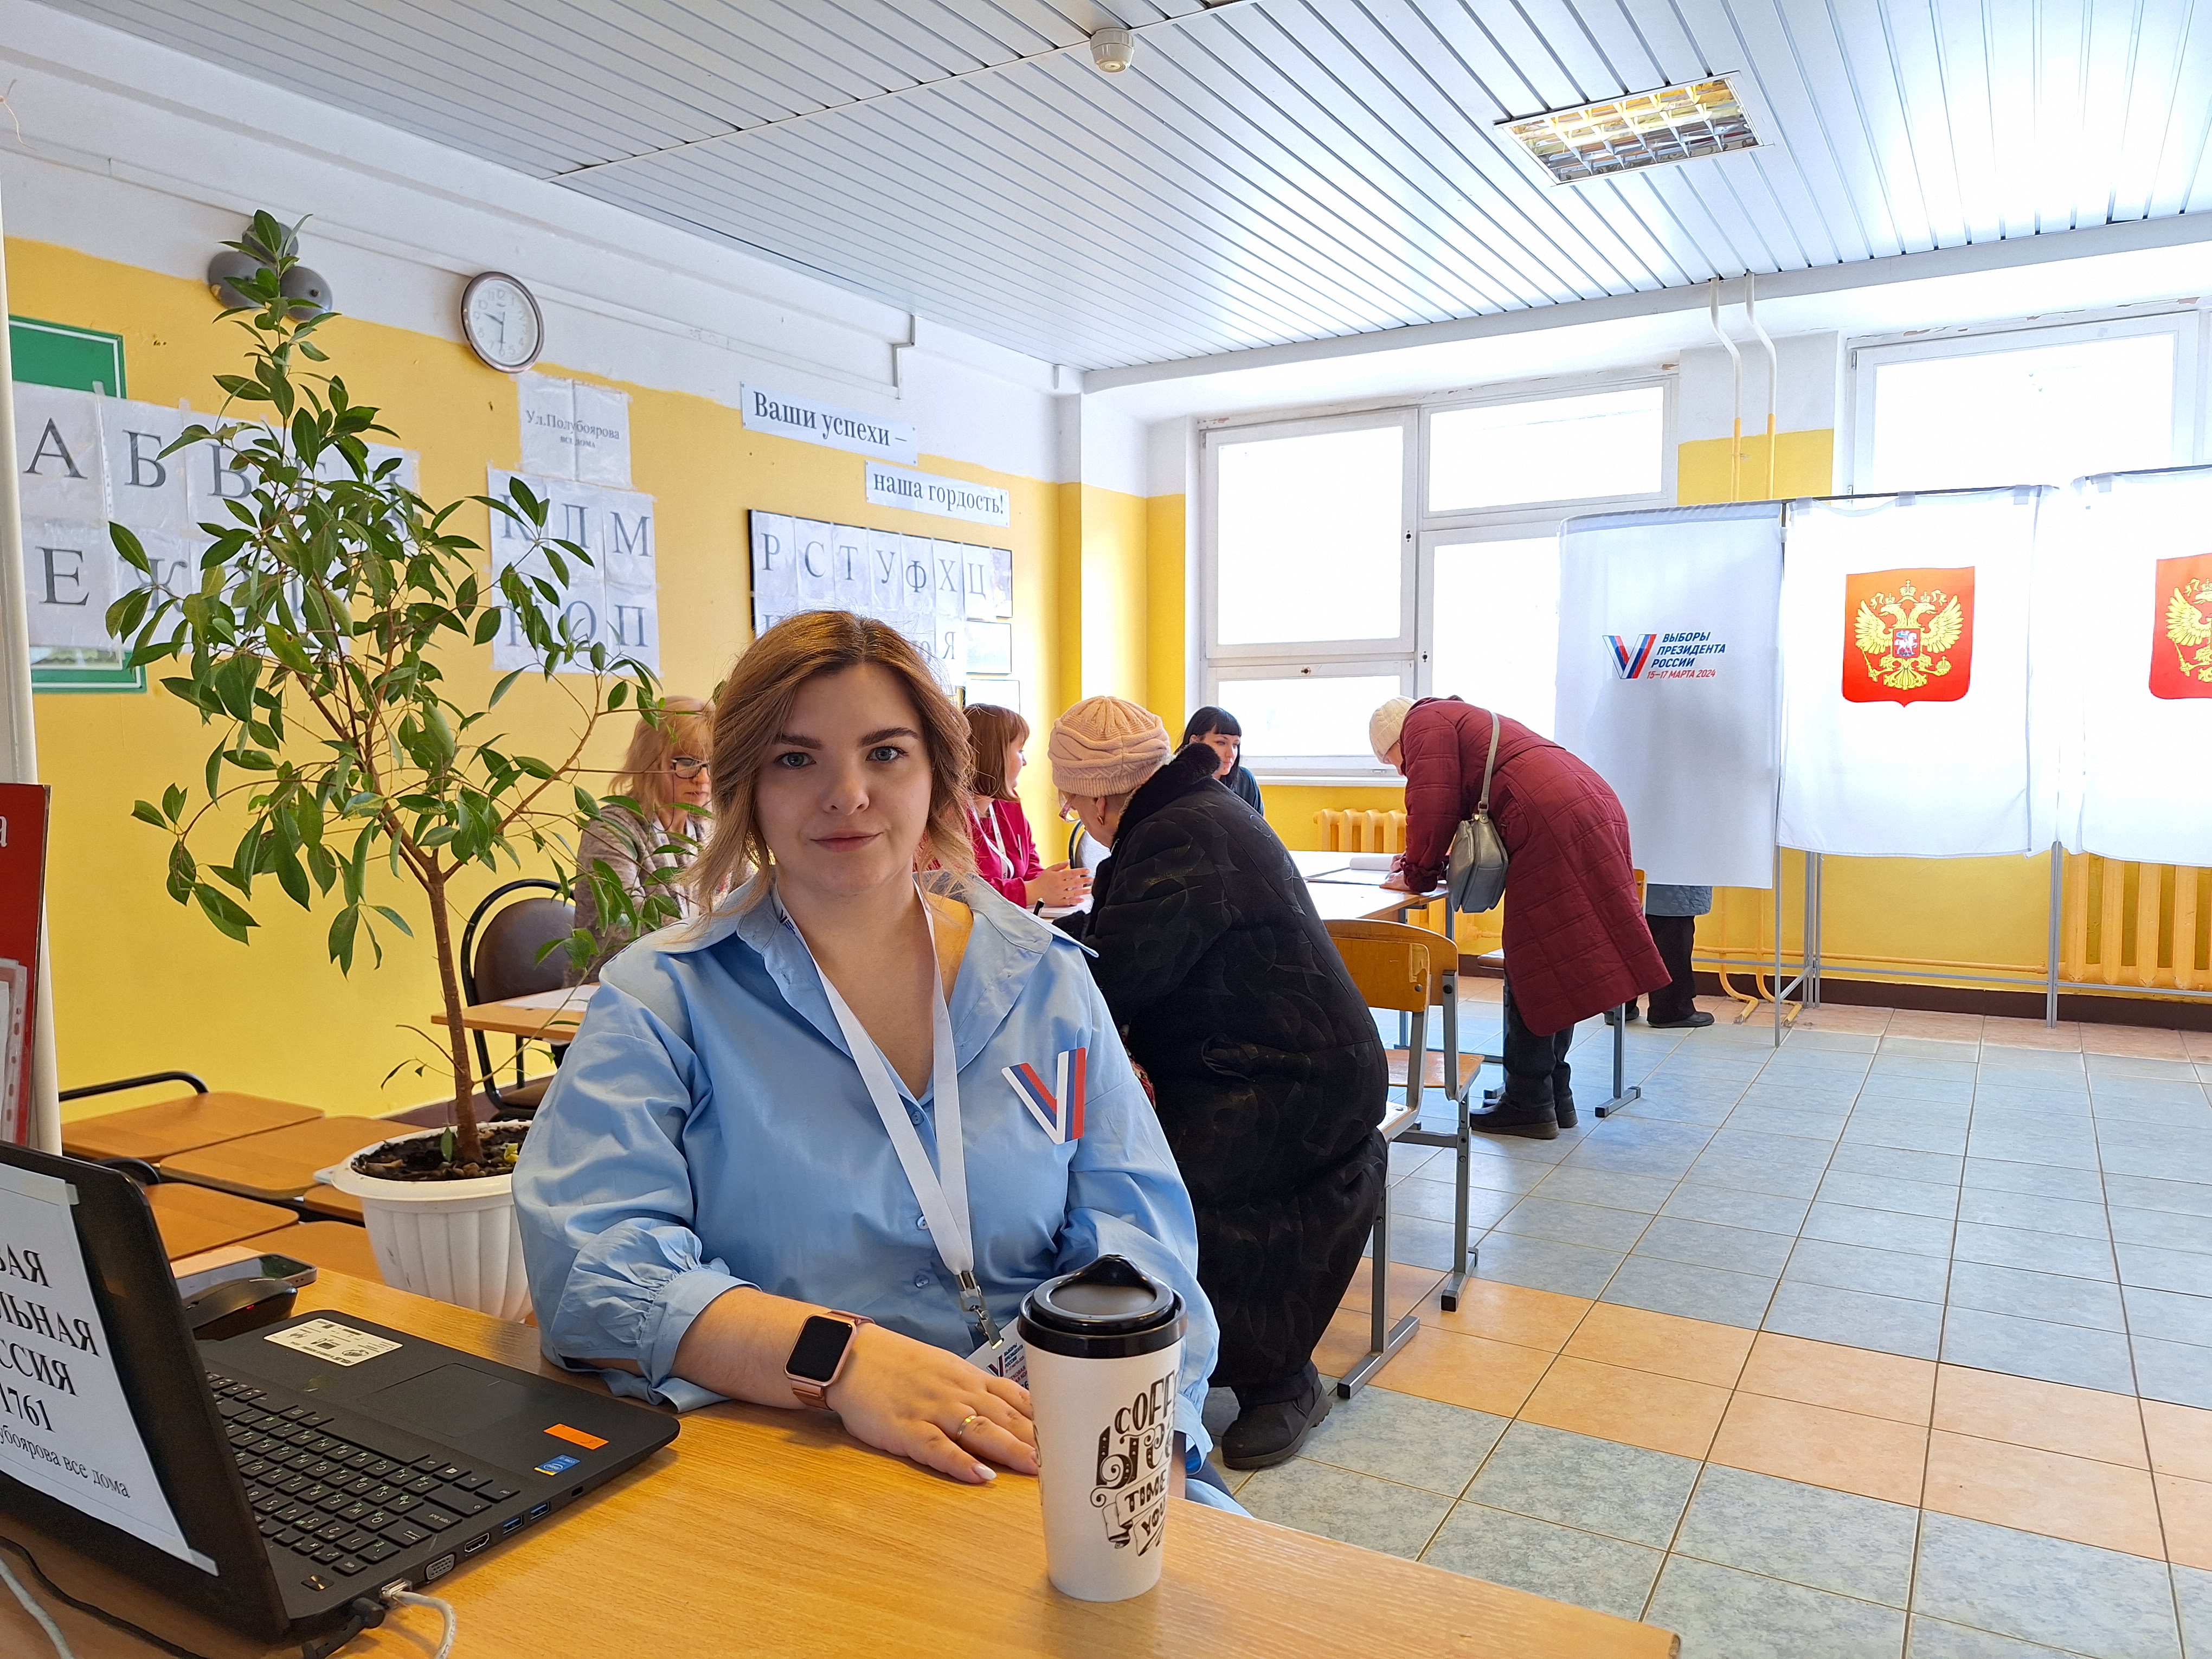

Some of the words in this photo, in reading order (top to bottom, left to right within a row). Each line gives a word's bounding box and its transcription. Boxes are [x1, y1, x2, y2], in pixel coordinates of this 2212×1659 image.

[753, 391, 817, 429] Ваши
[821, 413, 890, 446] успехи
[22, 417, 88, 480] А
[122, 429, 166, 488] Б
[874, 473, 924, 499] наша
[929, 484, 1004, 515] гордость!
[561, 504, 590, 549] Л
[610, 512, 653, 558] М
[35, 546, 90, 606] Е
[761, 532, 781, 571] Р
[805, 541, 826, 578] С
[839, 545, 858, 581] Т
[876, 550, 896, 584] У
[905, 561, 927, 593] Ф
[938, 559, 958, 593] Х
[967, 563, 986, 600] Ц
[565, 600, 597, 645] О
[615, 605, 650, 648] П
[942, 631, 956, 660] Я
[1662, 632, 1711, 643] ВЫБОРЫ
[1651, 658, 1695, 668] РОССИИ
[1656, 644, 1726, 656] ПРЕЗИДЕНТА
[1669, 670, 1695, 678] МАРТА
[1696, 669, 1716, 678] 2024
[1115, 1369, 1179, 1435] COFF
[62, 1456, 88, 1478] все
[91, 1469, 131, 1499] дома
[1124, 1469, 1167, 1513] TIME
